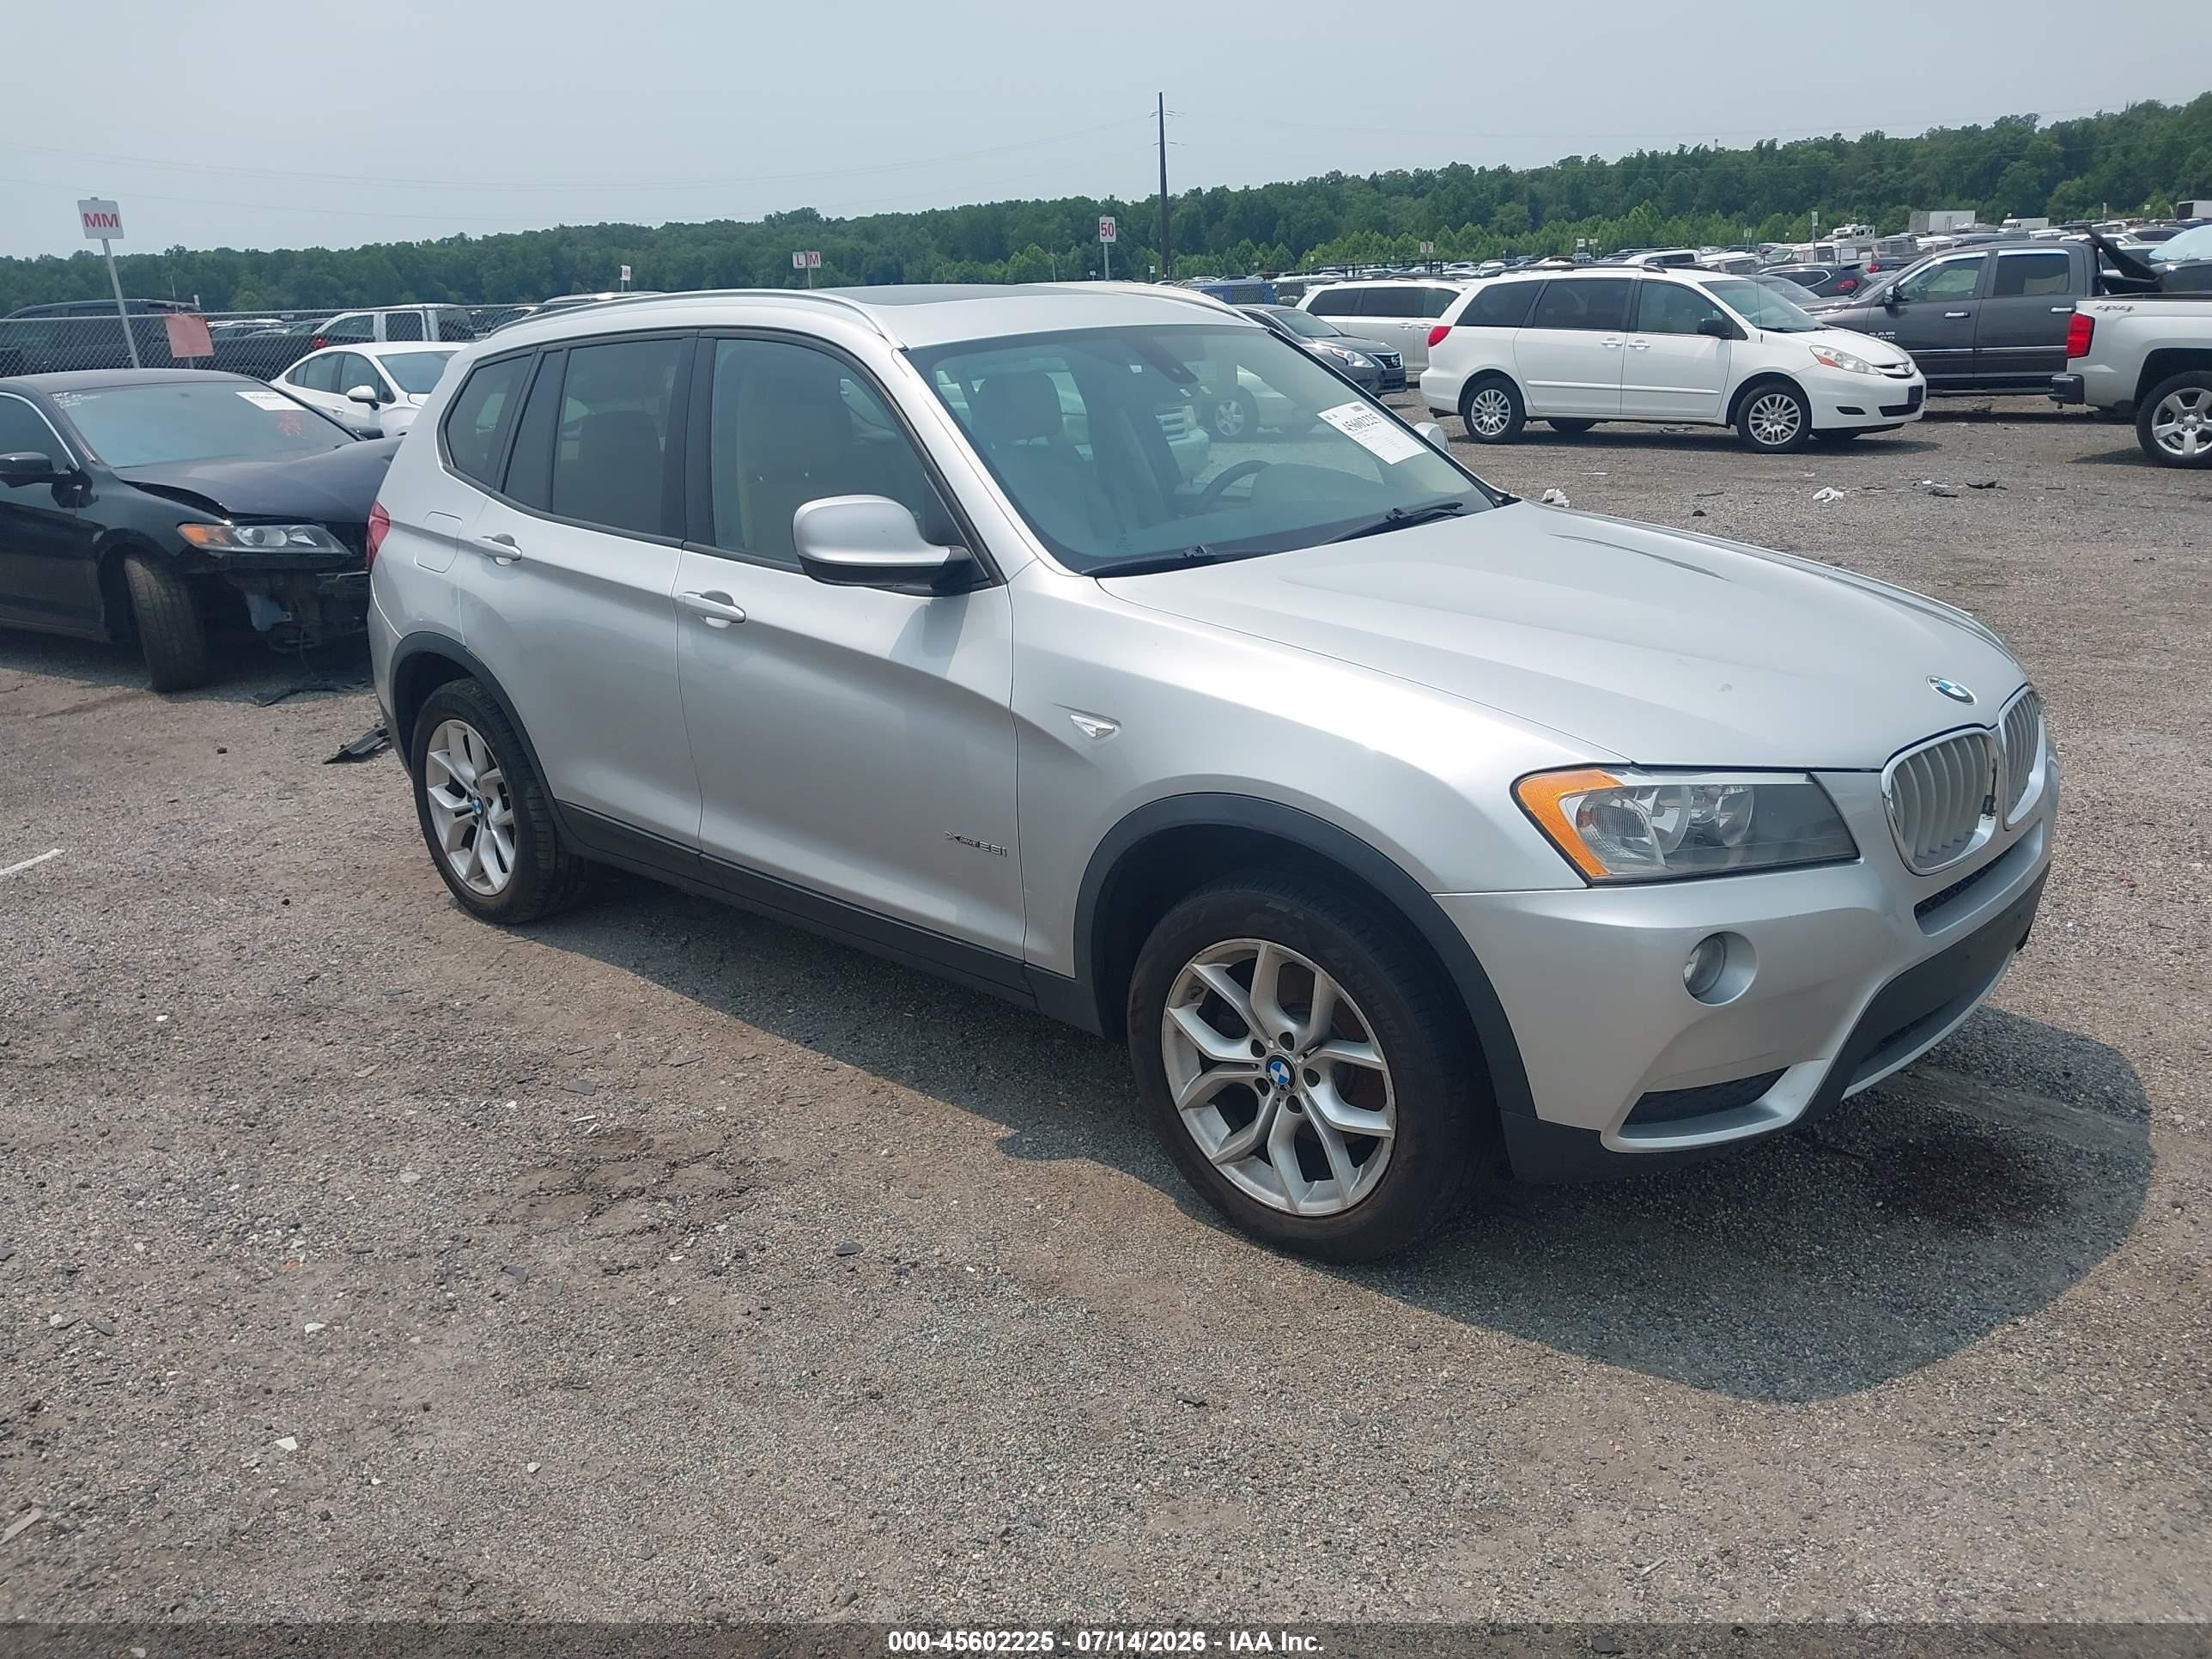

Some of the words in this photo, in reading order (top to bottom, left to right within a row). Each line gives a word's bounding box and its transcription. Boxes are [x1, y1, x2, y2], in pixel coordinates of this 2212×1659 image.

[83, 213, 118, 228] MM
[1101, 222, 1115, 237] 50
[796, 254, 804, 265] L
[810, 254, 819, 265] M
